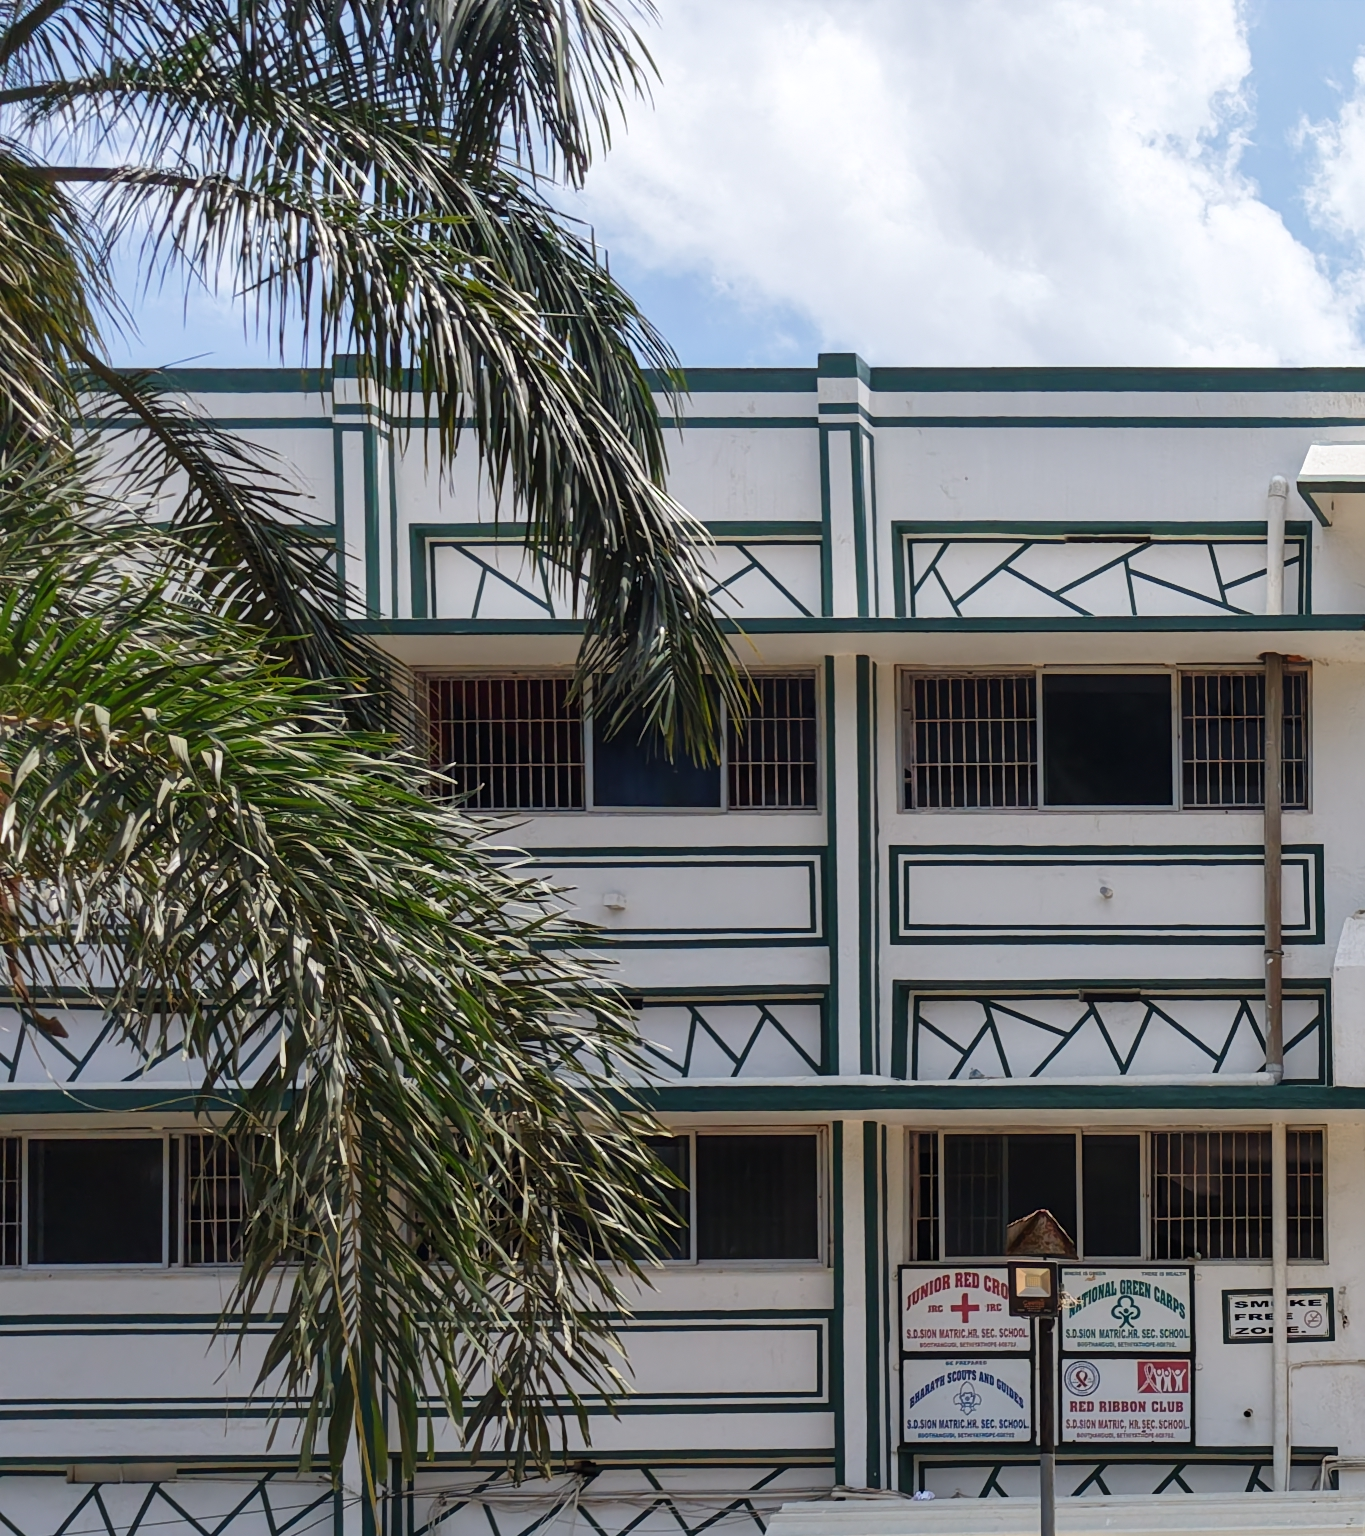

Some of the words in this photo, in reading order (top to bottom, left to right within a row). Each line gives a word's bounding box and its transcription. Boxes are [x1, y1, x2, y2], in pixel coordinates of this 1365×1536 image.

[906, 1274, 950, 1311] JUNIOR
[955, 1272, 979, 1289] RED
[984, 1275, 1009, 1300] CRO
[1120, 1279, 1151, 1299] GREEN
[1154, 1286, 1185, 1319] CARPS
[1234, 1299, 1322, 1308] SMKE
[928, 1305, 943, 1313] JRC
[986, 1303, 1002, 1312] JRC
[1235, 1326, 1306, 1335] ZOE.
[909, 1375, 945, 1409] BHARATH
[947, 1369, 977, 1384] SCOUTS
[979, 1371, 994, 1386] AND
[996, 1379, 1024, 1409] GUIDES
[1070, 1401, 1094, 1413] RED
[1099, 1401, 1146, 1413] RIBBON
[1151, 1401, 1184, 1413] CLUB
